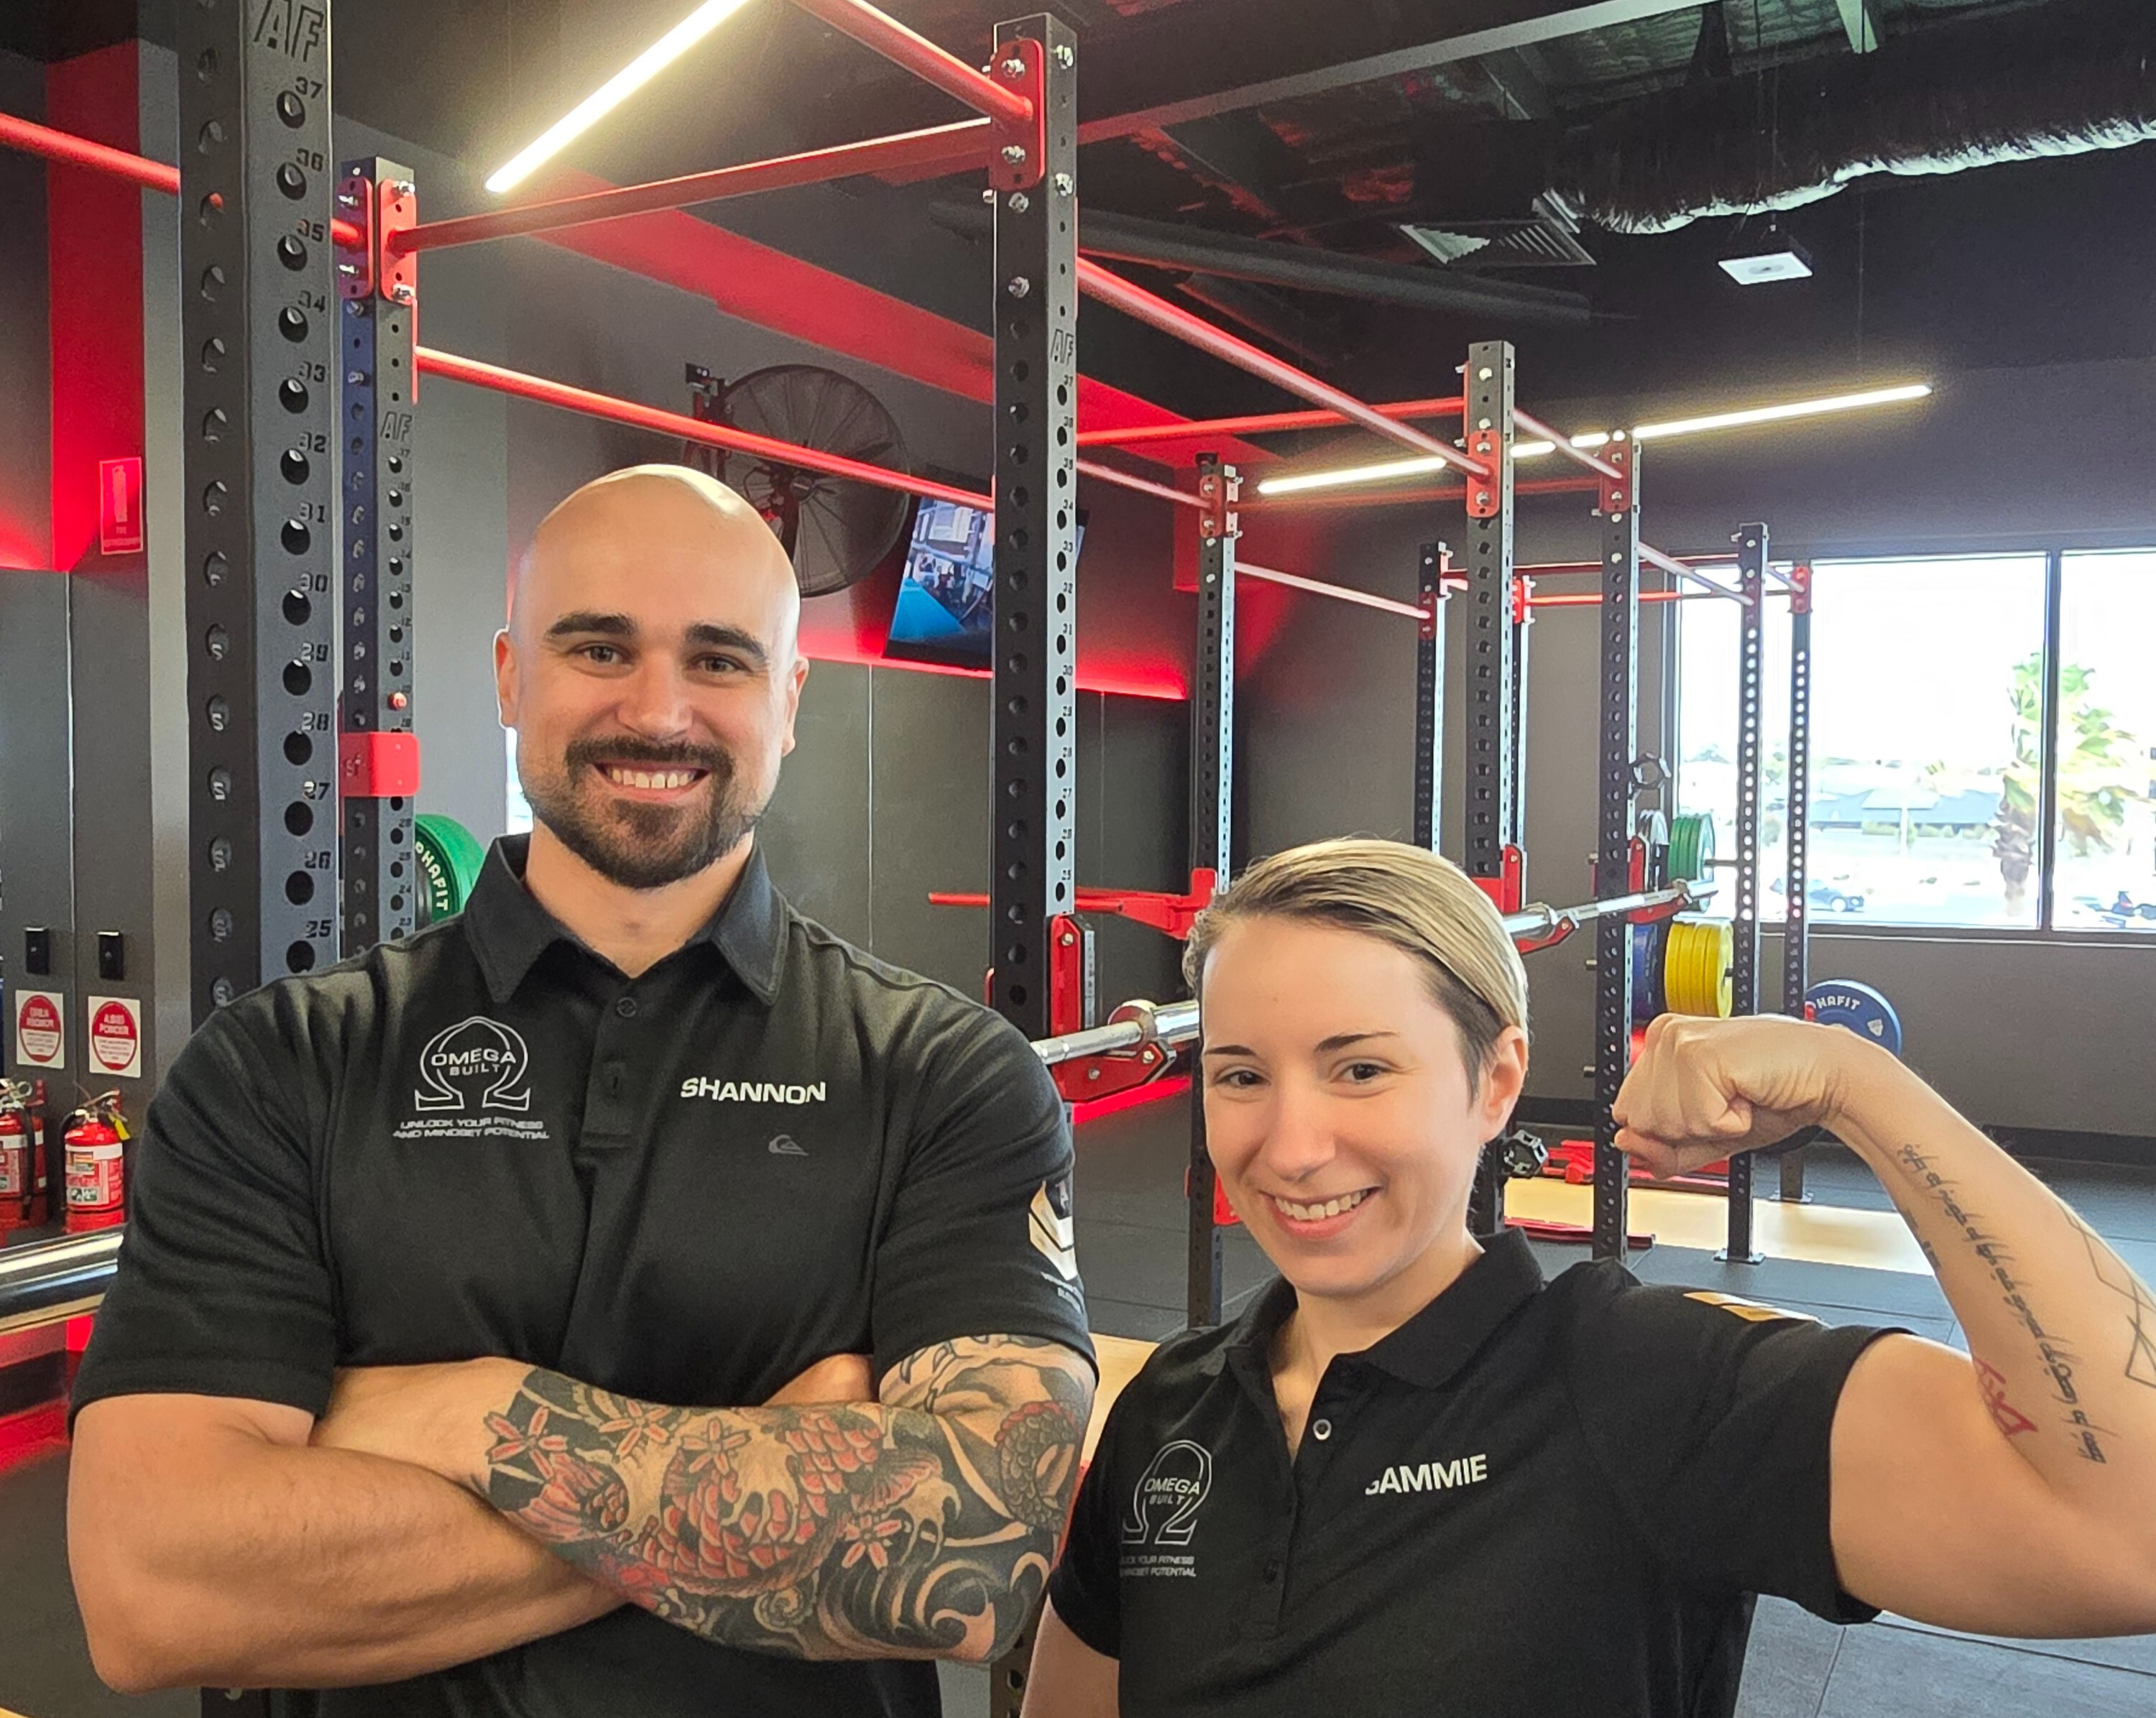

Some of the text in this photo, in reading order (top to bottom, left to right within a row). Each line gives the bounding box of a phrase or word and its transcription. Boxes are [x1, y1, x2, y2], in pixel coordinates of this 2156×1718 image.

[295, 76, 323, 99] 37
[297, 218, 325, 242] 35
[298, 290, 326, 313] 34
[298, 361, 326, 383] 33
[298, 431, 327, 453] 32
[299, 502, 326, 524] 31
[300, 573, 328, 592] 30
[301, 642, 328, 662] 29
[302, 712, 329, 731] 28
[303, 781, 331, 800] 27
[305, 920, 333, 938] 25
[431, 1048, 517, 1066] OMEGA
[449, 1063, 500, 1076] BUILT
[681, 1076, 826, 1104] SHANNON
[400, 1116, 544, 1130] UNLOCK YOUR FITNESS
[392, 1127, 550, 1140] AND MINDSET POTENTIAL
[1144, 1477, 1200, 1495] OMEGA
[1149, 1495, 1186, 1505] BUILT
[1158, 1555, 1195, 1565] FITNESS
[1150, 1567, 1197, 1577] POTENTIAL
